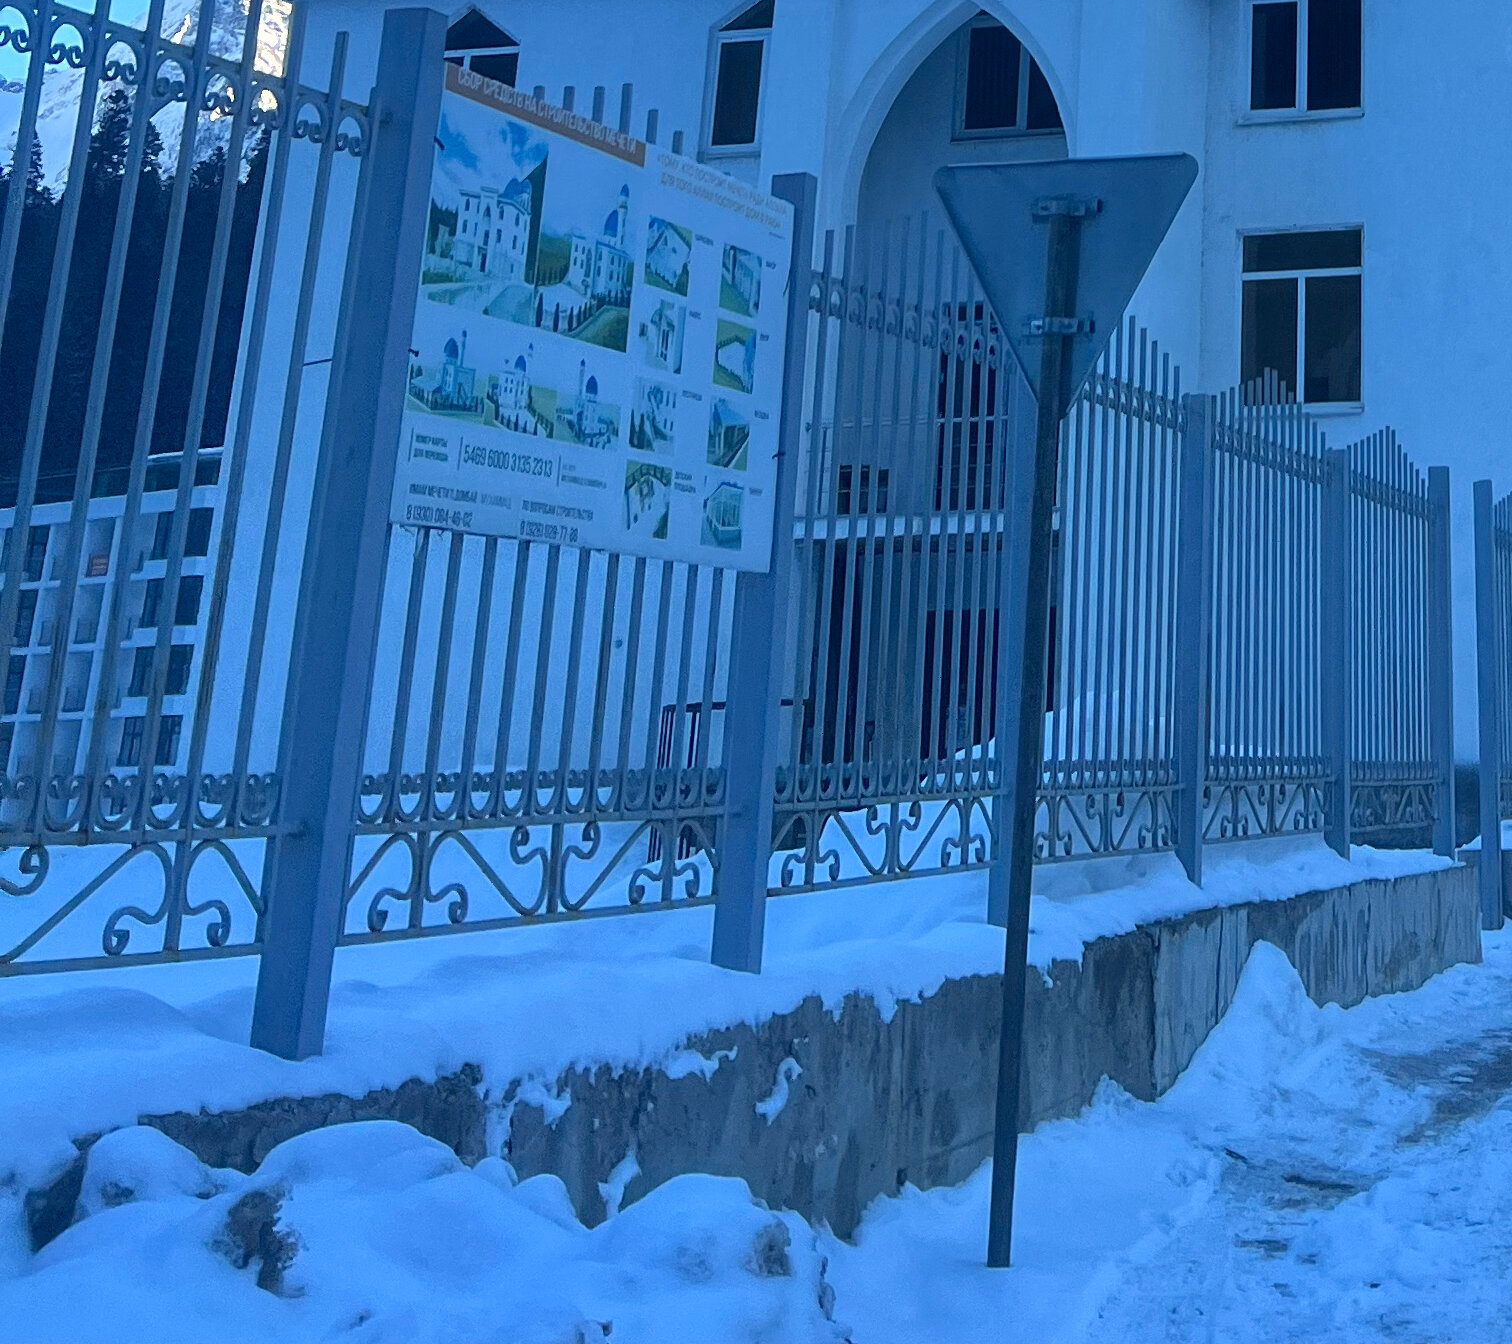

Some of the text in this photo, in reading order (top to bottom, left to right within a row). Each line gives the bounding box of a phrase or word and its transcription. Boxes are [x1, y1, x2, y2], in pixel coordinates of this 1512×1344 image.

[457, 67, 637, 154] СБОР СРЕДСТВ НА СТРОИТЕЛЬСТВО МЕЧЕТИ
[463, 444, 487, 466] 5469
[487, 448, 510, 470] 6000
[511, 452, 531, 474] 3135
[532, 456, 553, 478] 2313
[406, 504, 412, 521] 8
